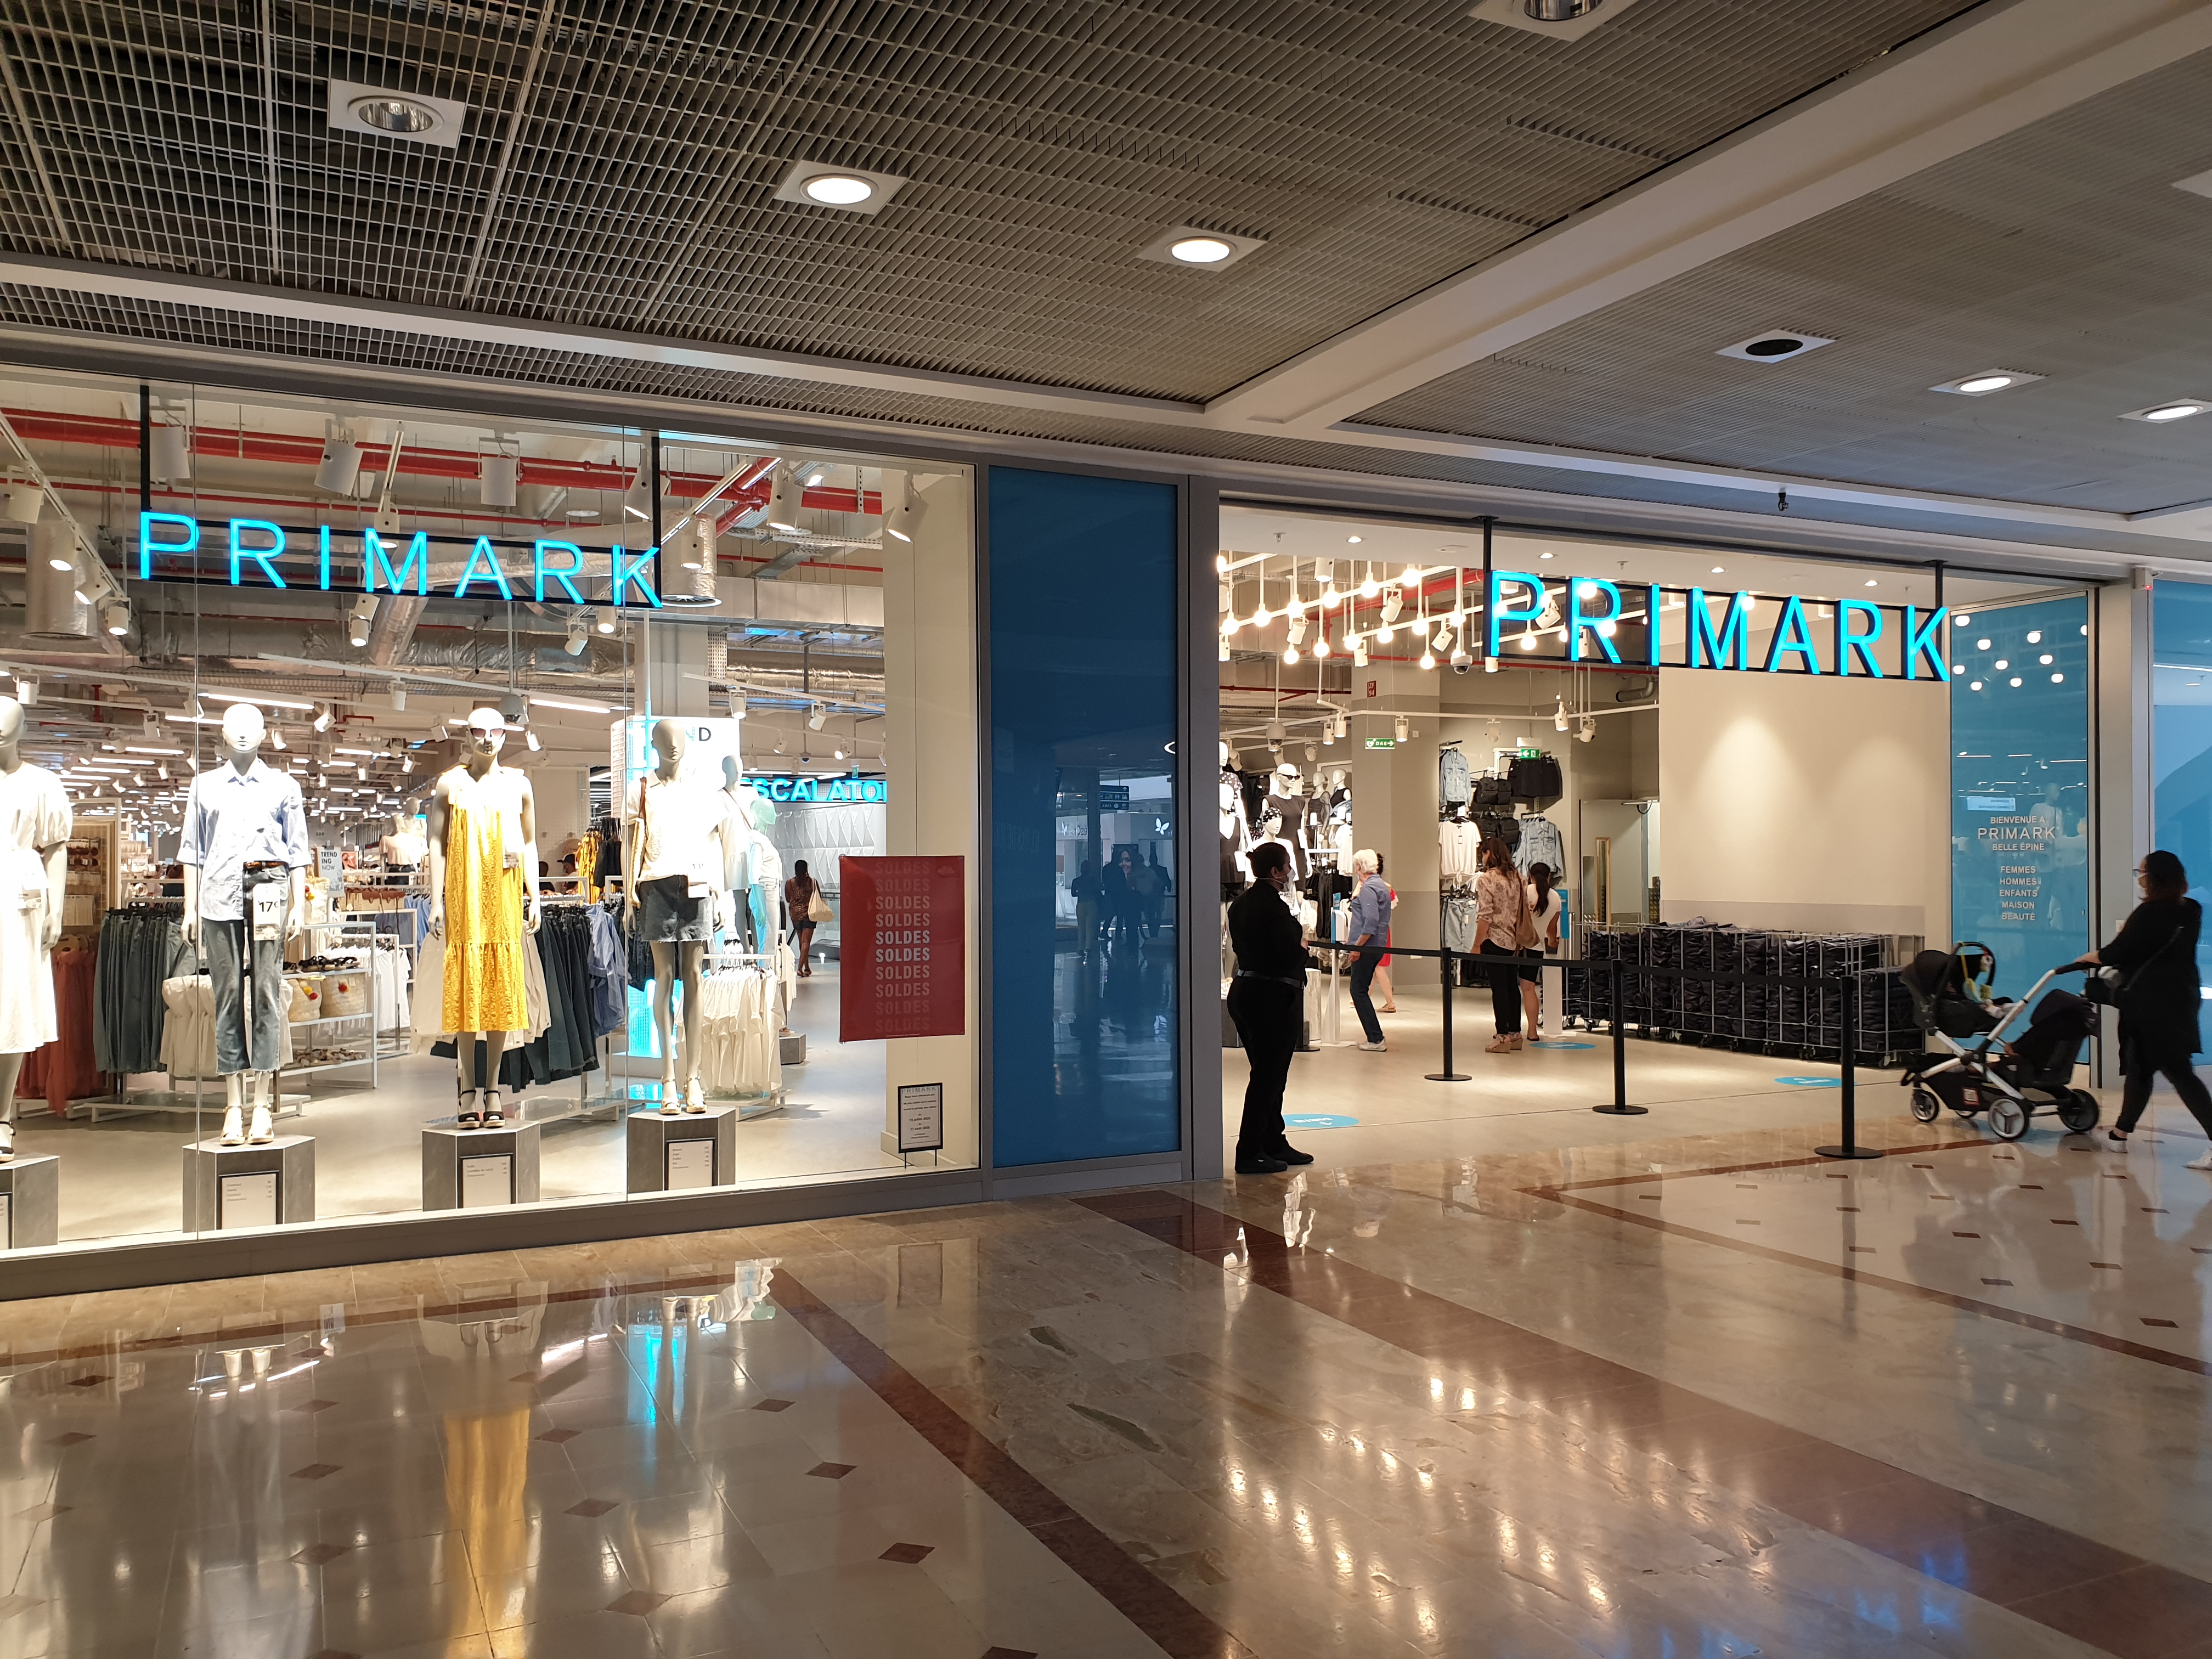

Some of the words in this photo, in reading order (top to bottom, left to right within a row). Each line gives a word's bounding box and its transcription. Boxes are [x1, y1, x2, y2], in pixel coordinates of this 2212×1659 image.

[140, 512, 663, 608] PRIMARK
[1489, 571, 1950, 681] PRIMARK
[741, 778, 888, 803] SCALATO
[1978, 826, 2056, 840] PRIMARK
[2020, 842, 2045, 851] ÉPINE
[1999, 889, 2038, 897] ENFANTS
[876, 895, 930, 910] SOLDES
[876, 913, 930, 927] SOLDES
[876, 930, 930, 945] SOLDES
[876, 947, 930, 962] SOLDES
[876, 965, 930, 980] SOLDES
[876, 982, 930, 998] SOLDES
